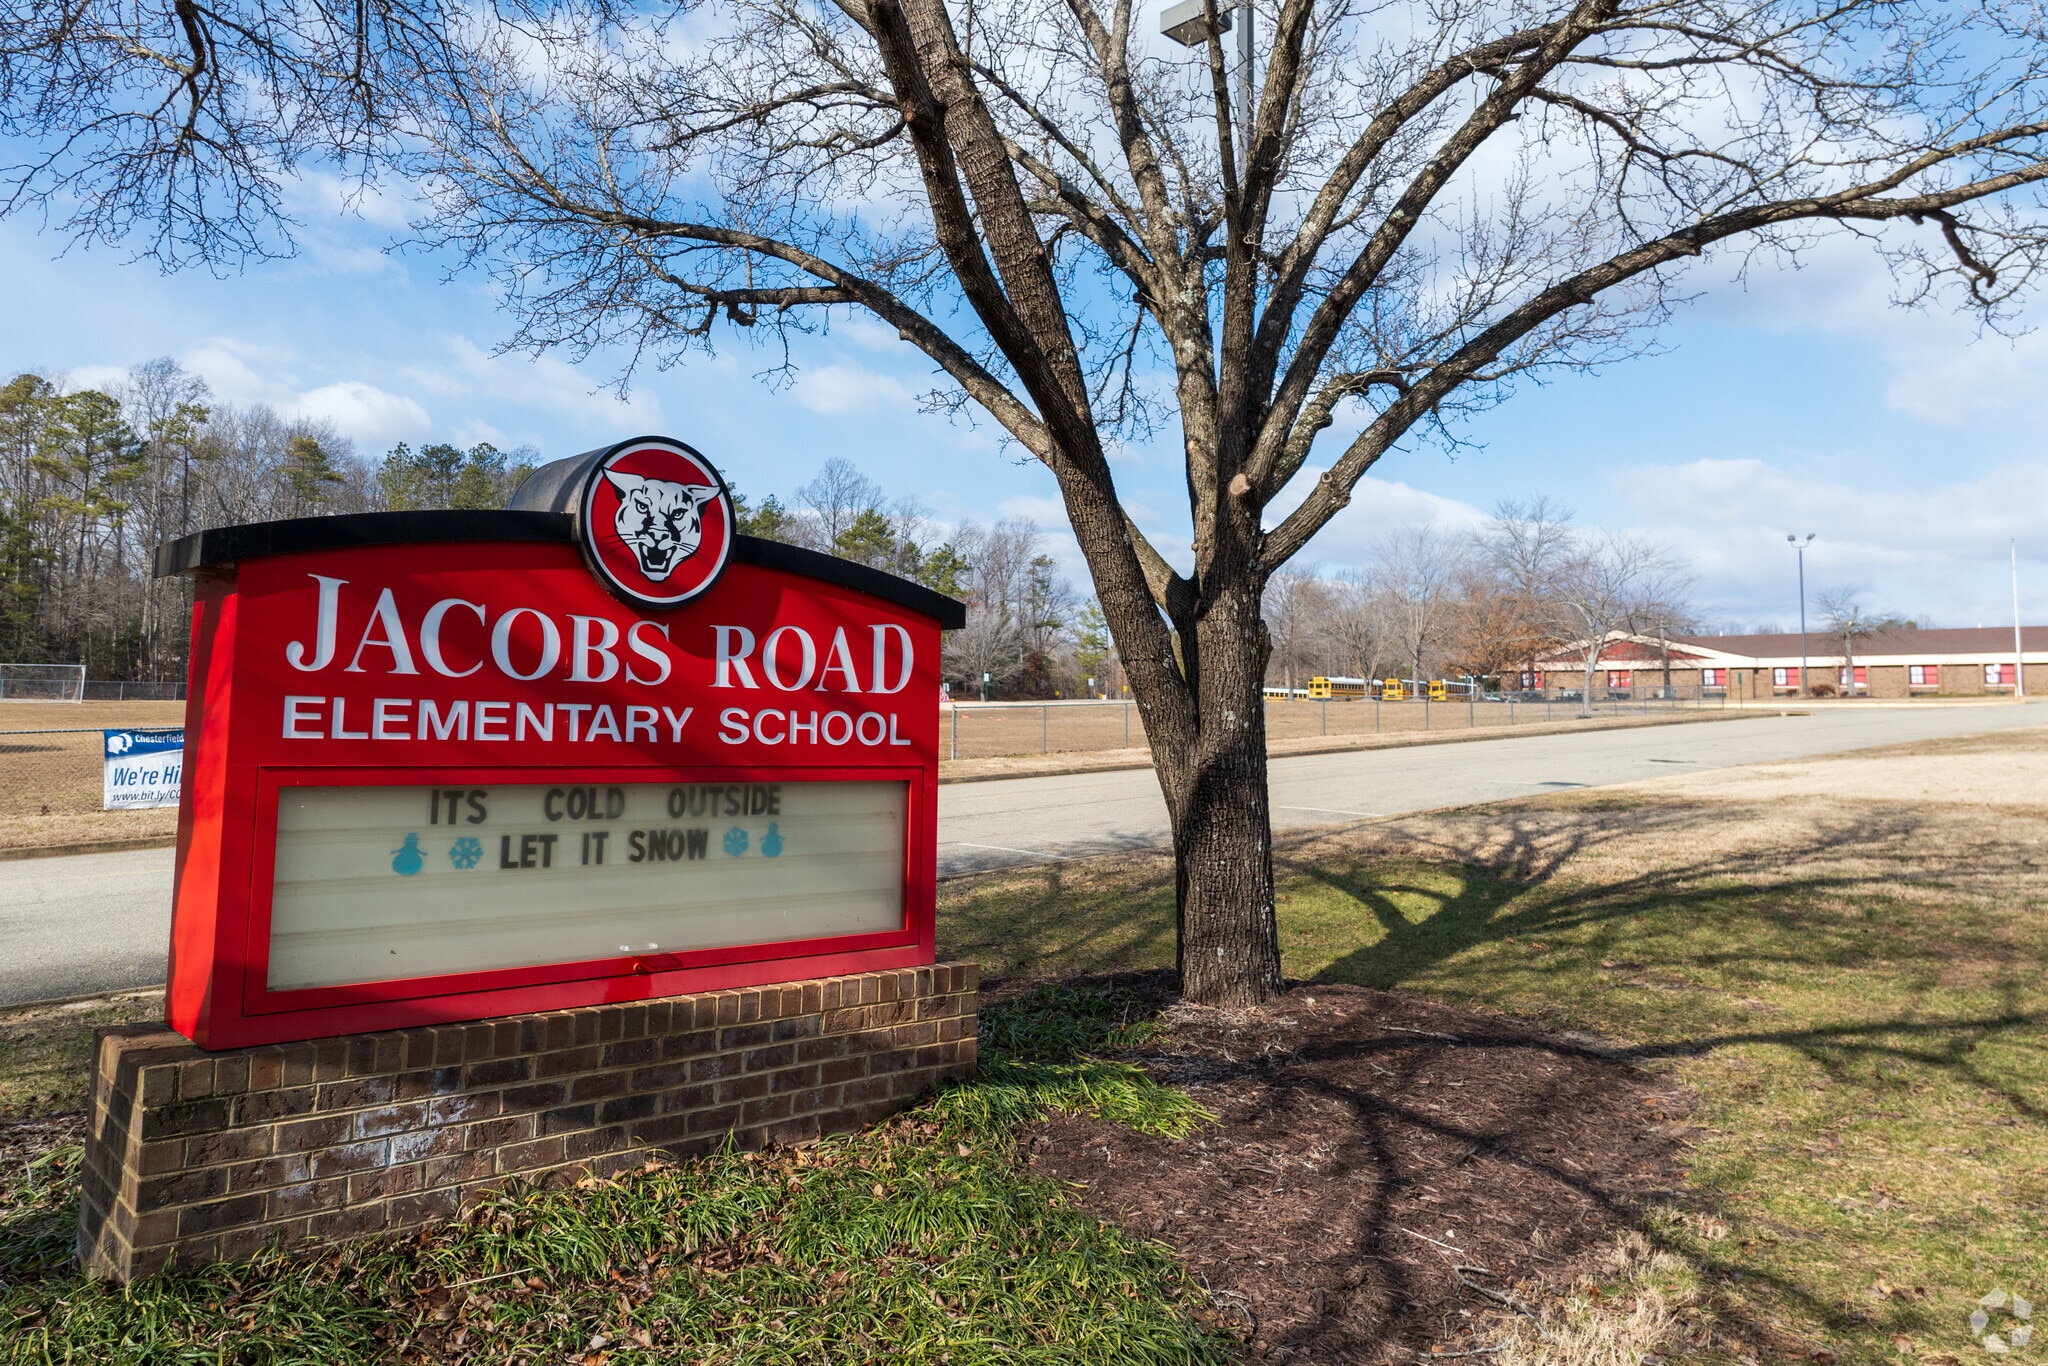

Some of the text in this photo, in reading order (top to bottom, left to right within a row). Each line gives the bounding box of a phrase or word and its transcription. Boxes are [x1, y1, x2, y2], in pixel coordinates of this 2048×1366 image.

[286, 573, 914, 695] JACOBS ROAD
[135, 733, 184, 743] Chesterfield
[282, 695, 911, 747] ELEMENTARY SCHOOL
[113, 765, 182, 787] We're Hi
[430, 785, 781, 825] ITS COLD OUTSIDE
[500, 828, 709, 869] LET IT SNOW
